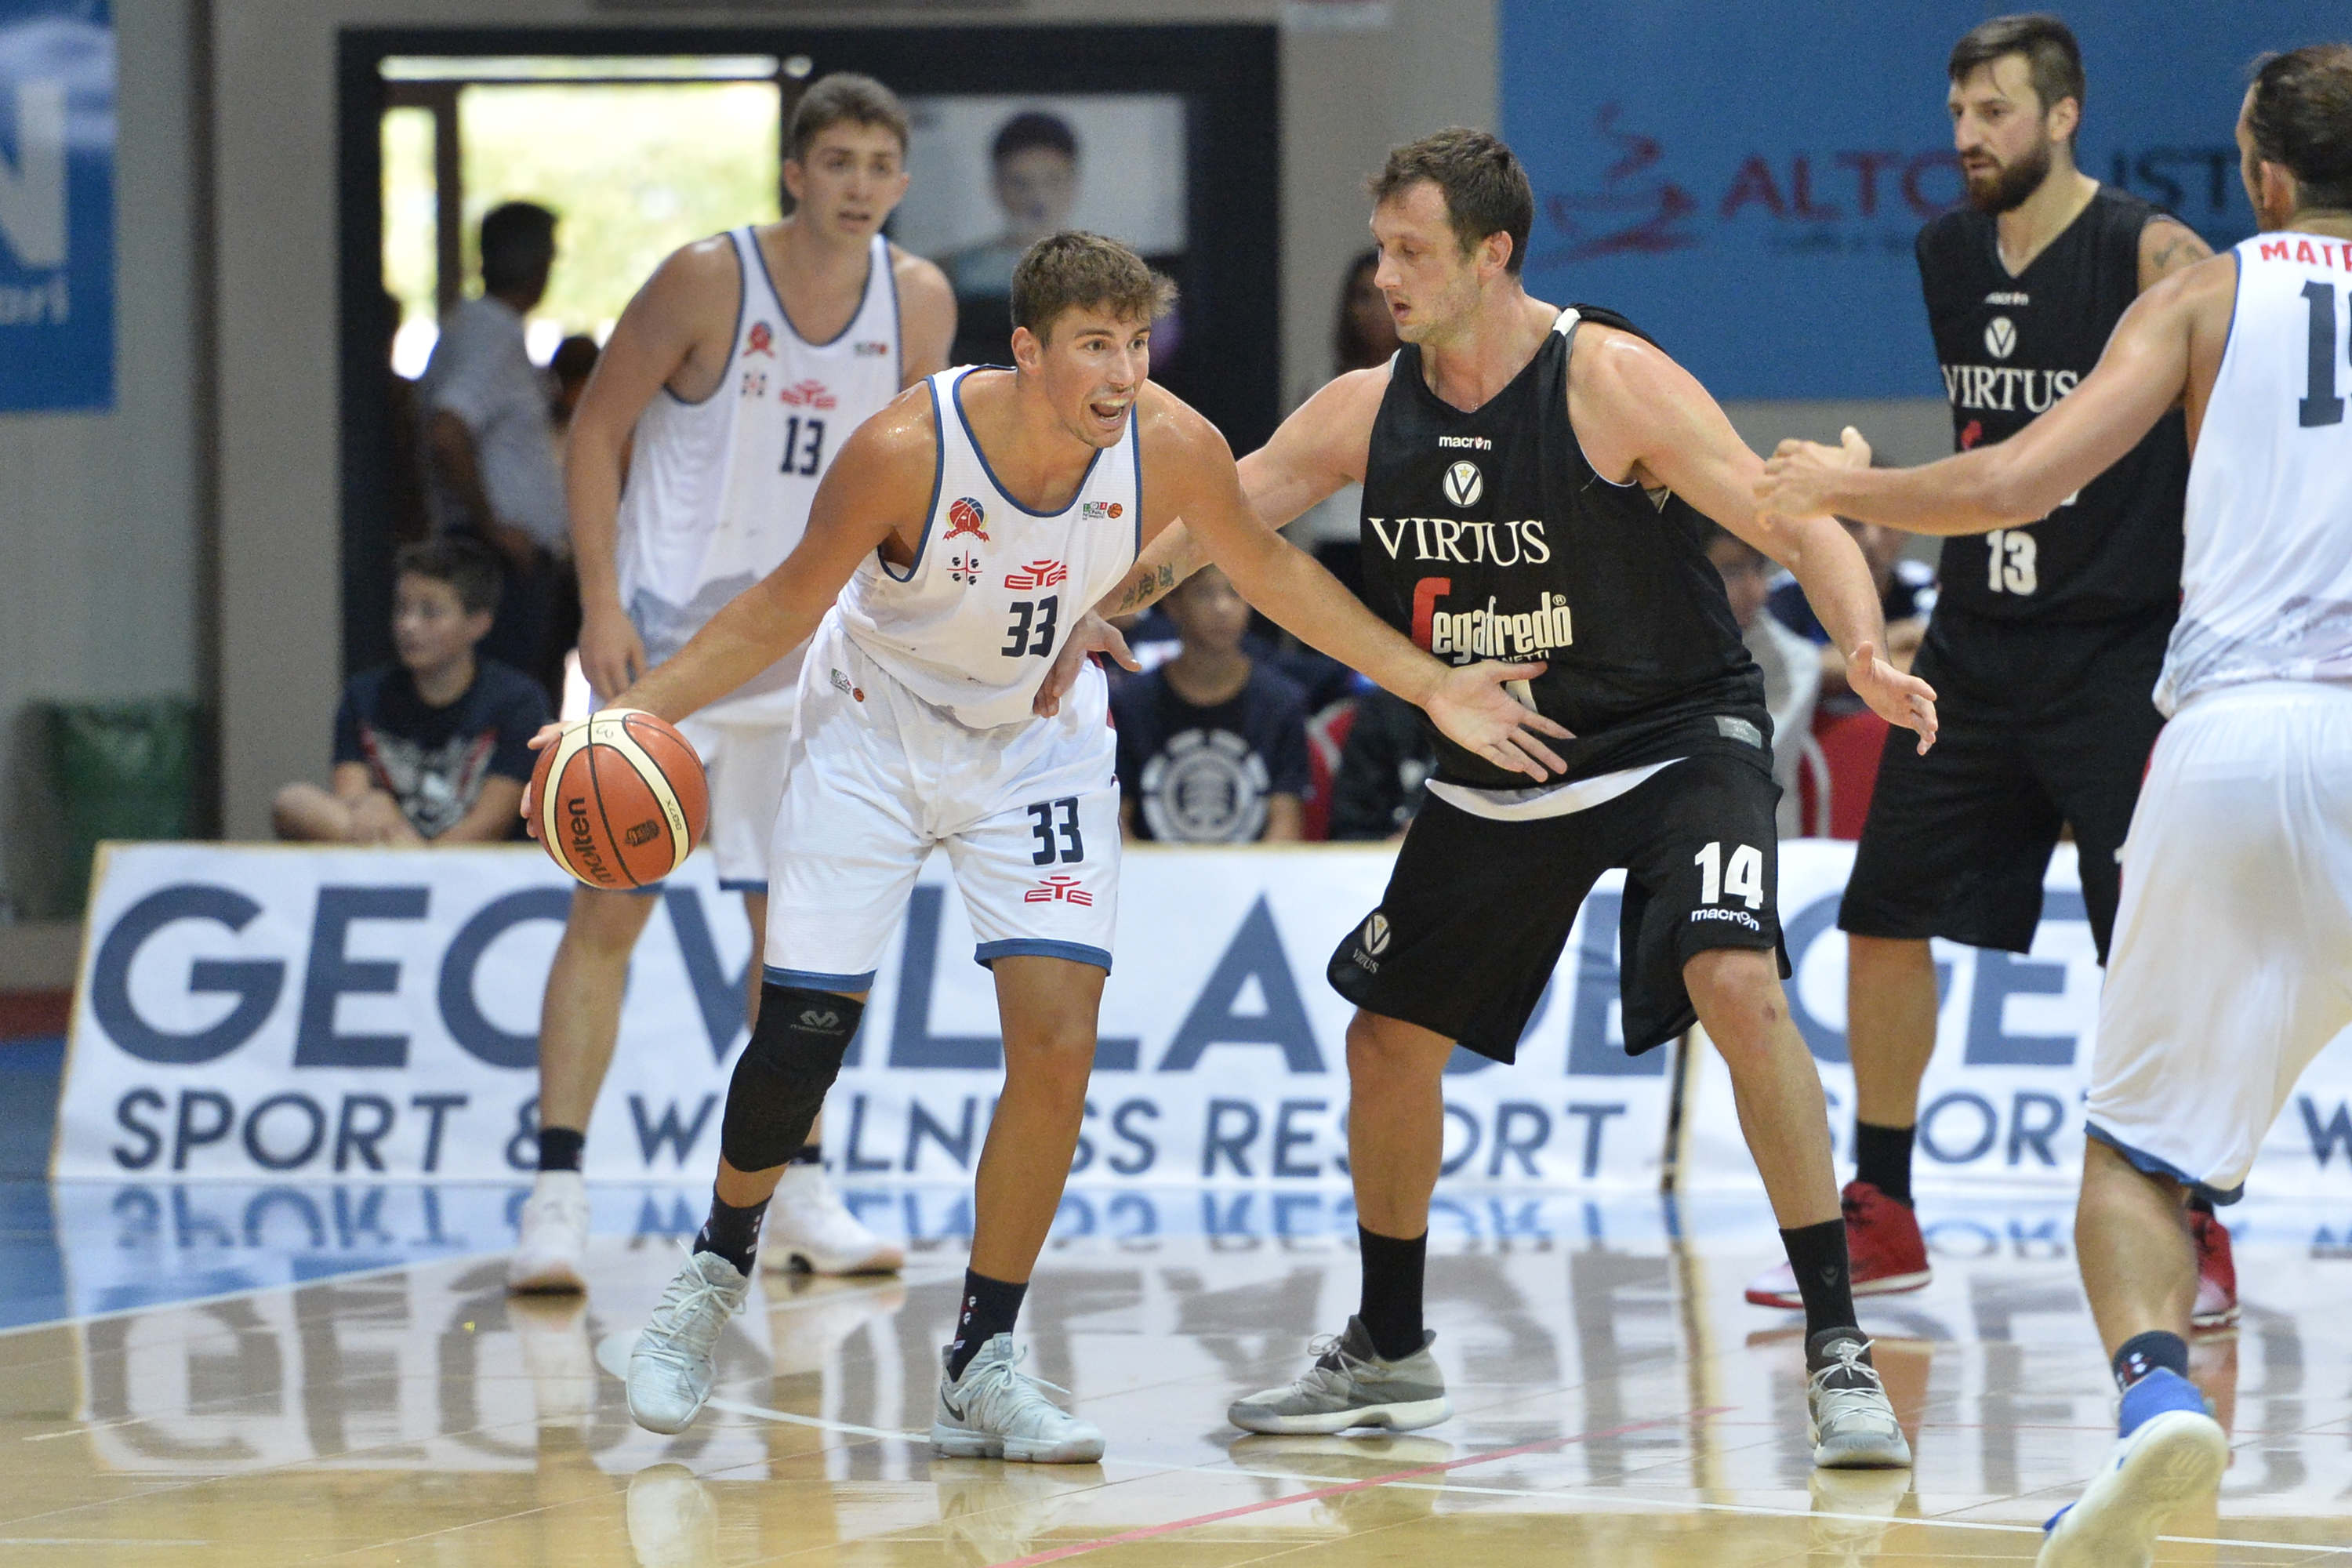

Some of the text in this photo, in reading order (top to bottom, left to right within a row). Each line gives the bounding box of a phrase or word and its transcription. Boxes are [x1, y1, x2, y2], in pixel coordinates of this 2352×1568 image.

[2299, 280, 2352, 428] 1
[1941, 365, 2078, 413] VIRTUS
[781, 416, 826, 475] 13
[1439, 436, 1492, 452] macron
[1368, 517, 1551, 567] VIRTUS
[1986, 528, 2038, 596] 13
[1001, 594, 1058, 658] 33
[568, 797, 618, 883] molten
[1027, 797, 1084, 866] 33
[1694, 841, 1763, 909] 14
[1690, 908, 1761, 931] macron
[114, 1087, 467, 1173] SPORT
